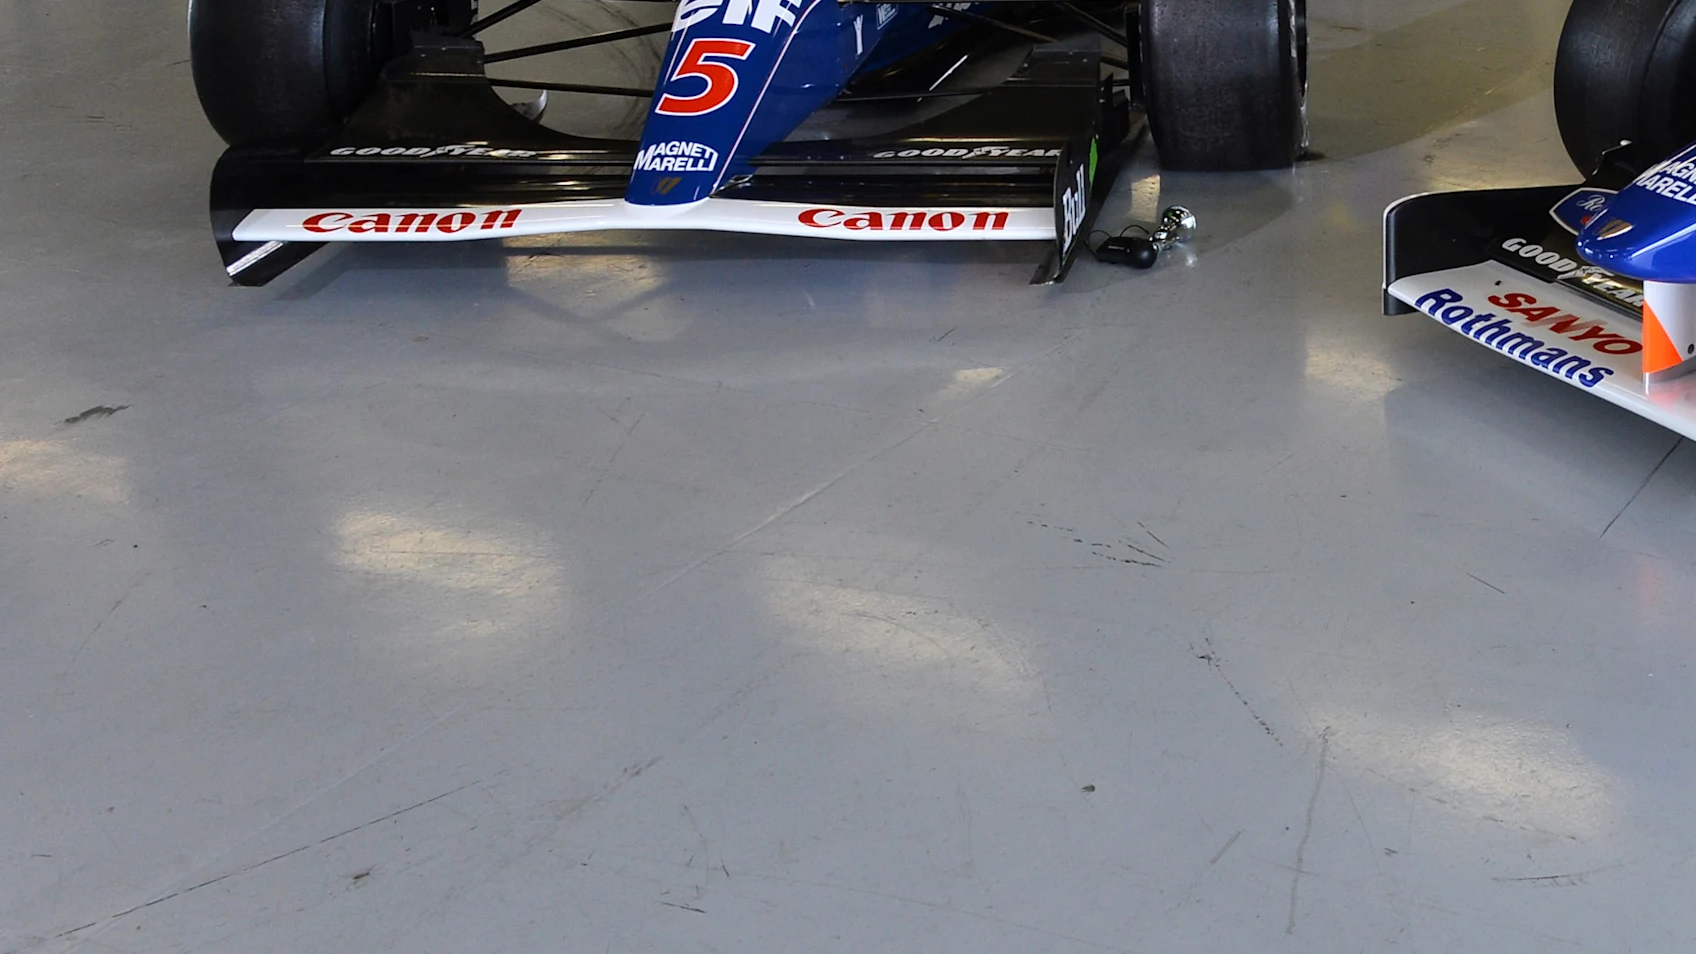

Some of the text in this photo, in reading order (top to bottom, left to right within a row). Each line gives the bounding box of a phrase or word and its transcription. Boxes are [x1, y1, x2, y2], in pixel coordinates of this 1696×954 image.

[654, 38, 756, 116] 5
[330, 144, 537, 159] GOODYEAR
[873, 146, 1061, 159] GOODYEAR
[303, 209, 522, 234] Canon
[798, 208, 1009, 231] Canon
[1063, 164, 1086, 256] Bull
[1501, 237, 1644, 307] GOODYEAR
[1414, 287, 1615, 389] Rothmans
[1488, 291, 1643, 356] SANYO
